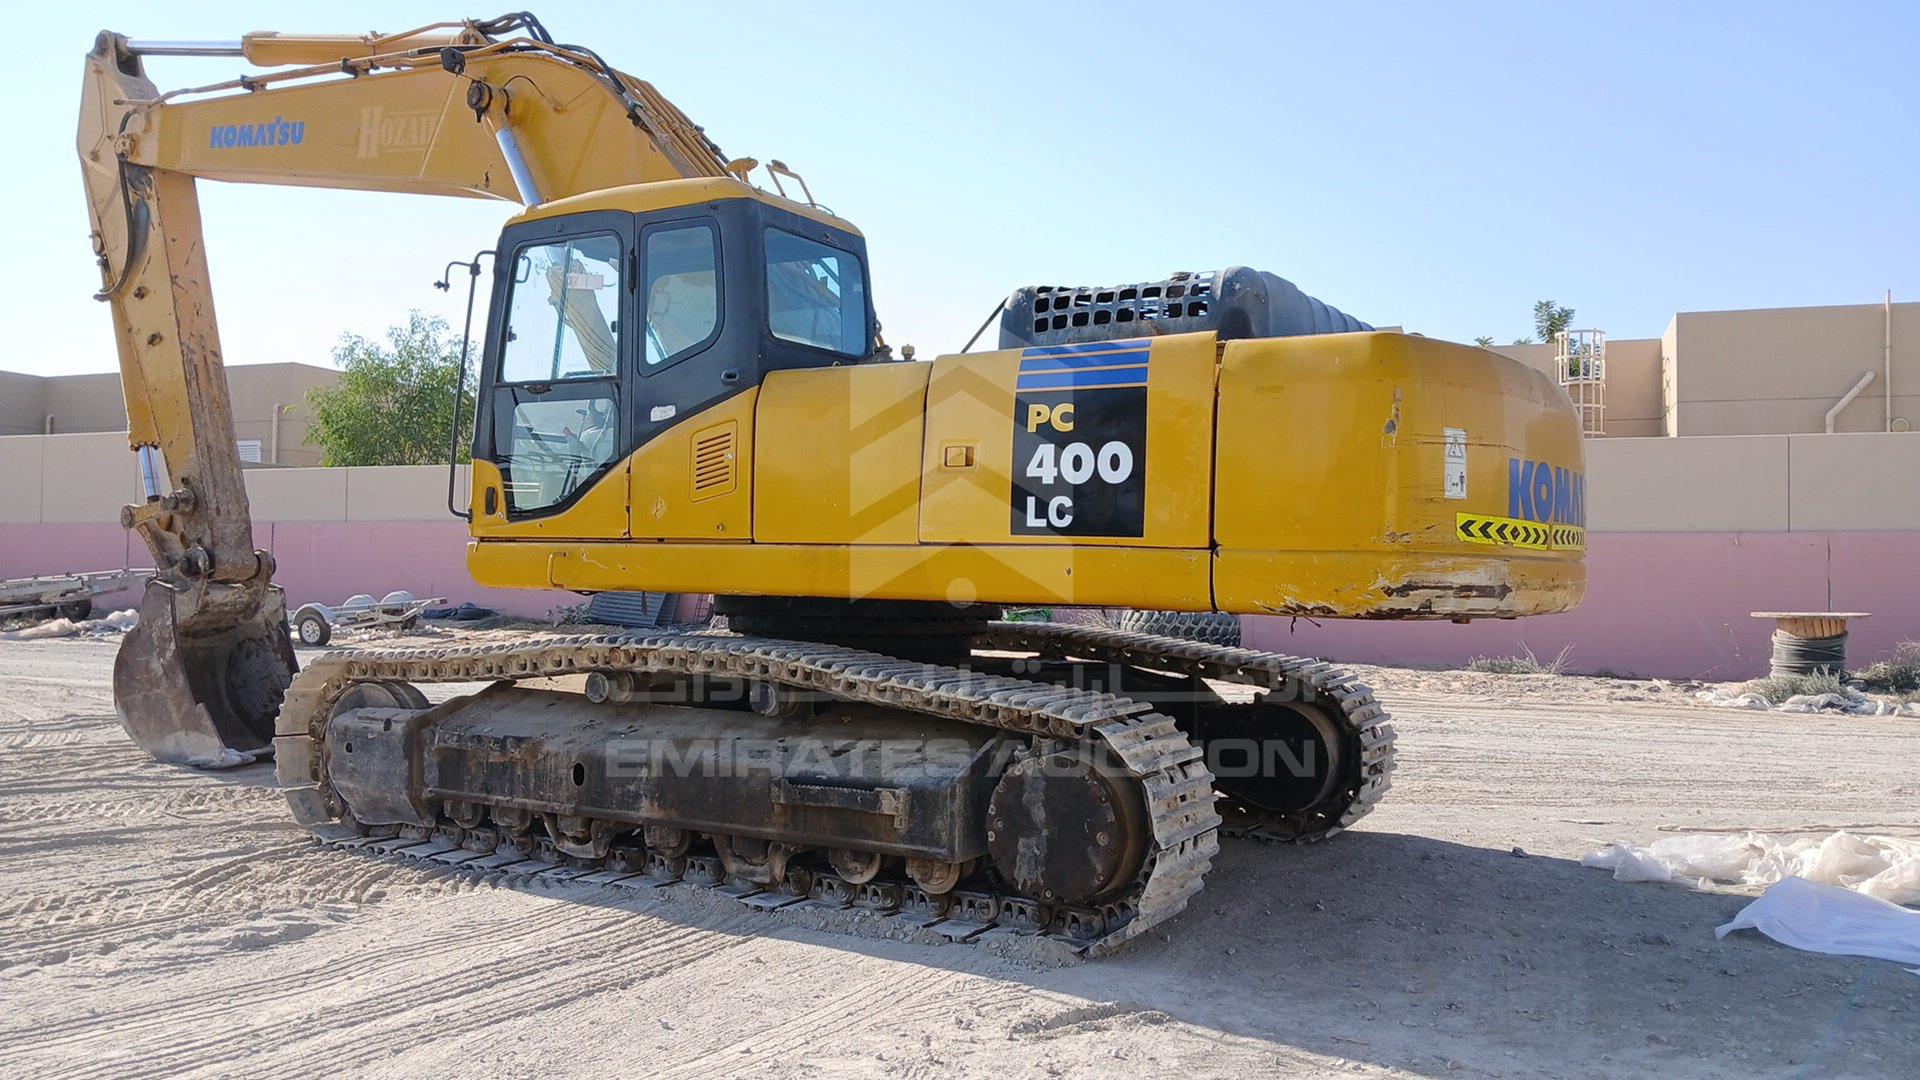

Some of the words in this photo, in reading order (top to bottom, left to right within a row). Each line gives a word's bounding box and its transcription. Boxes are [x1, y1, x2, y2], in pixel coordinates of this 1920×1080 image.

[1026, 402, 1075, 433] PC
[1025, 440, 1134, 485] 400
[1026, 495, 1074, 528] LC
